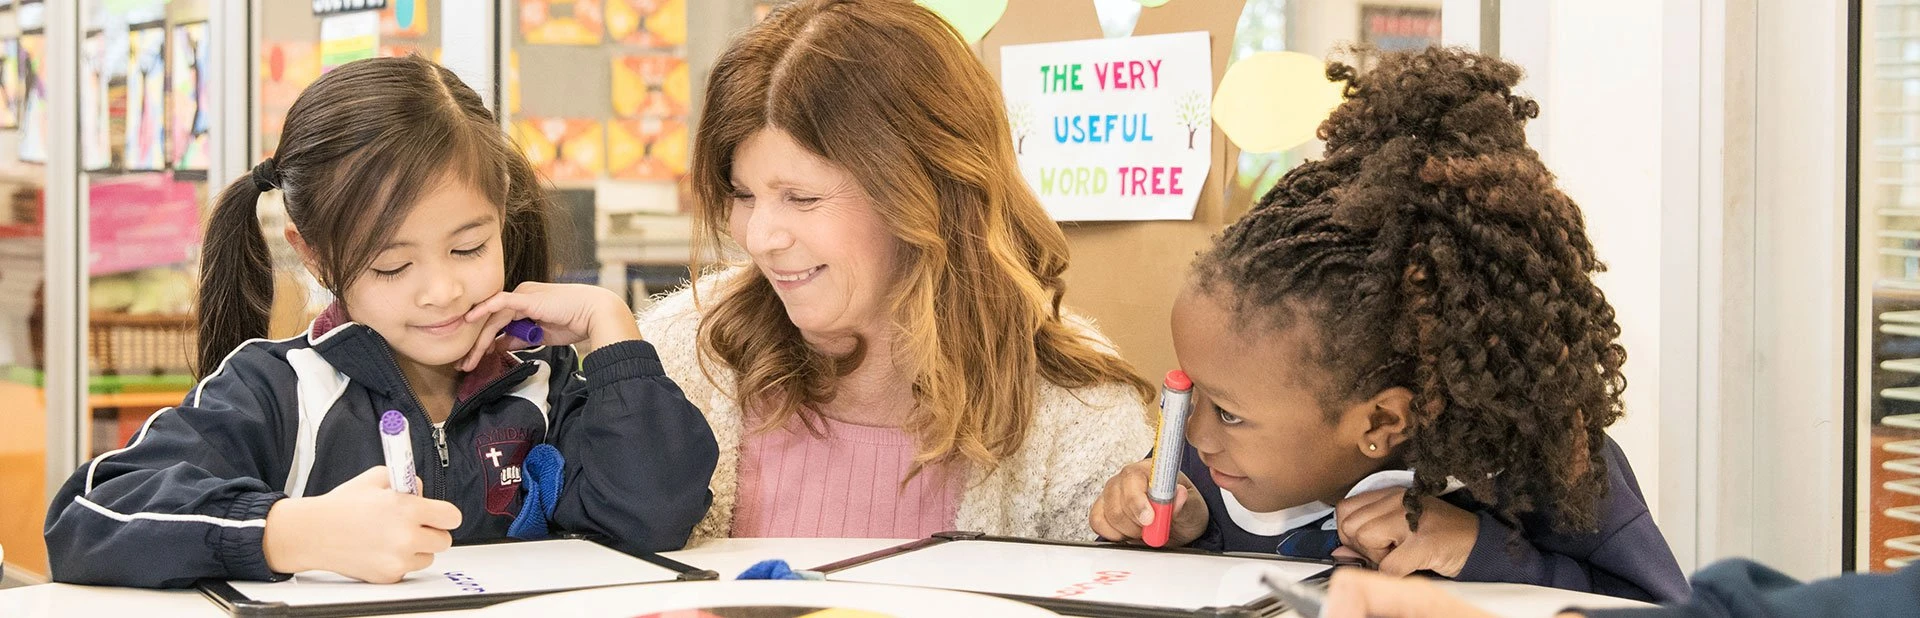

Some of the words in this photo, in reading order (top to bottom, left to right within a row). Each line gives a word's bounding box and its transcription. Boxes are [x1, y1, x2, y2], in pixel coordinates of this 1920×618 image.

[1040, 64, 1083, 93] THE
[1094, 59, 1162, 91] VERY
[1054, 113, 1153, 143] USEFUL
[1039, 166, 1108, 196] WORD
[1118, 166, 1183, 196] TREE
